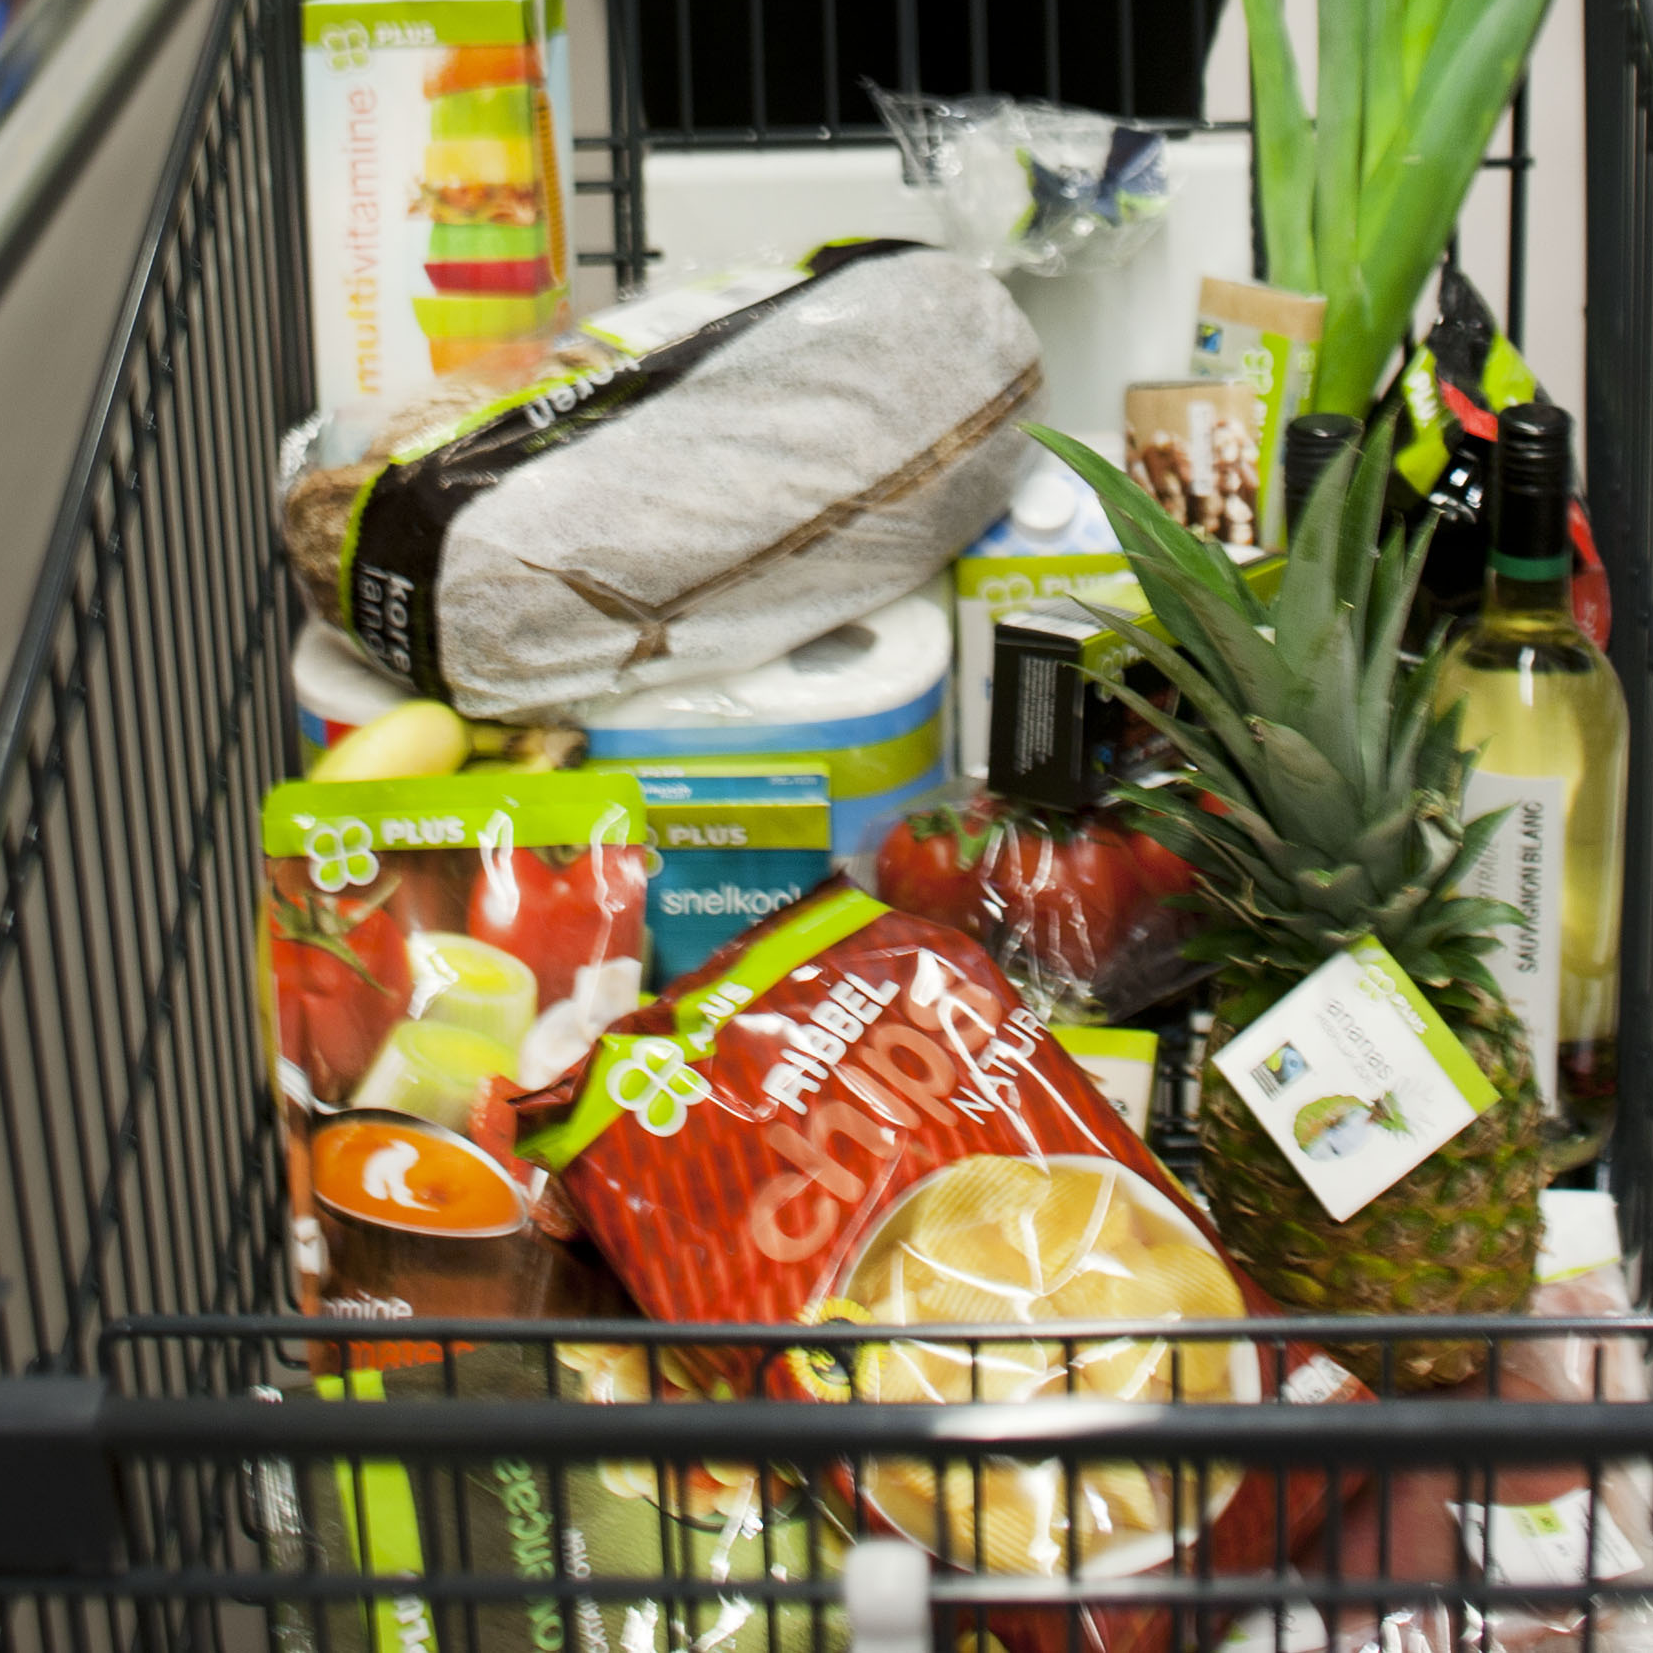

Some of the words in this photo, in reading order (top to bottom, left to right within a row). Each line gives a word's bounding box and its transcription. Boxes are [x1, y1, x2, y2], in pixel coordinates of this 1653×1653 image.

[374, 20, 437, 44] PLUS
[342, 84, 382, 396] multivitamine
[381, 815, 466, 845] PLUS
[666, 823, 749, 846] PLUS
[1521, 799, 1545, 866] BLANC
[659, 882, 802, 916] snelkoo
[760, 971, 901, 1116] RIBBEL
[1325, 998, 1395, 1081] ananas
[750, 966, 1003, 1263] chips
